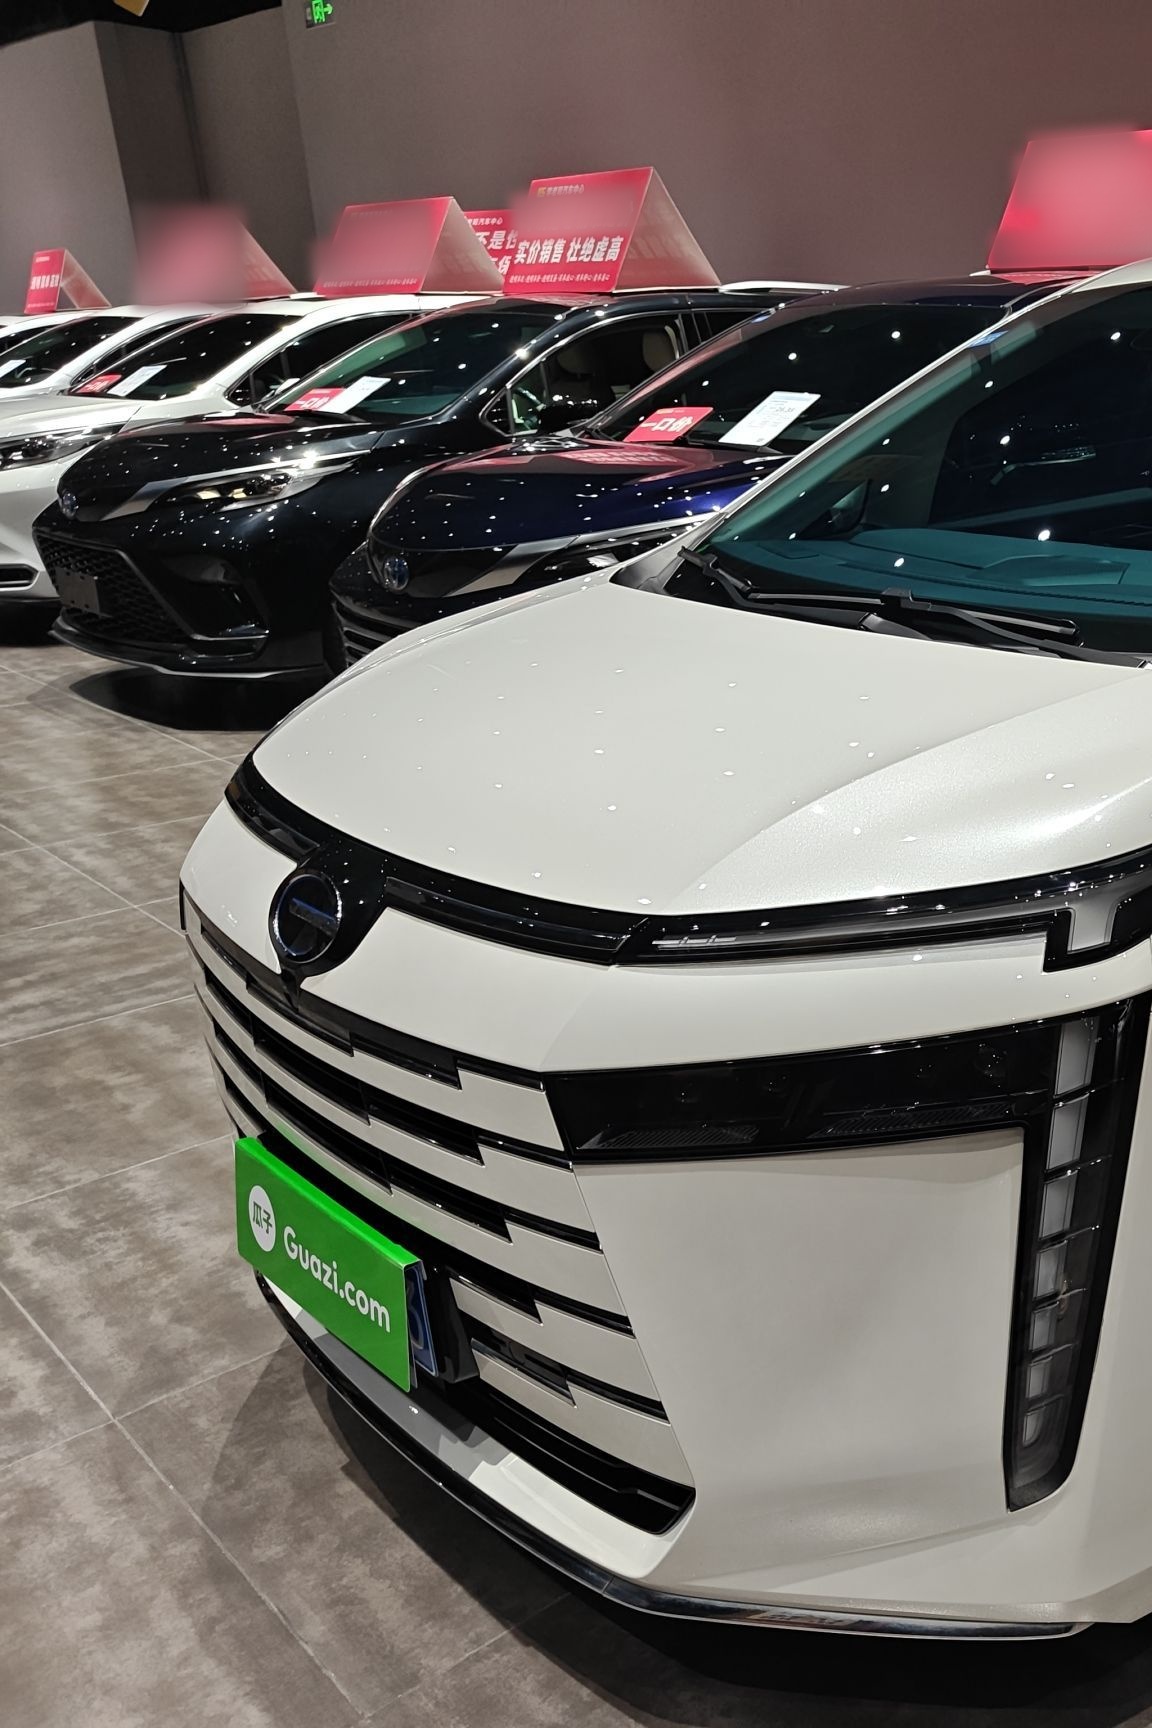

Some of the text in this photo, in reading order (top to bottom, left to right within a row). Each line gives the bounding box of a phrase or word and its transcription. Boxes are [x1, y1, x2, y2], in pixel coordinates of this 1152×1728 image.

[514, 235, 624, 265] 实价销售 杜绝虚高
[640, 415, 694, 433] 一口价
[252, 1201, 273, 1234] 瓜子
[283, 1225, 392, 1333] Guazi.com
